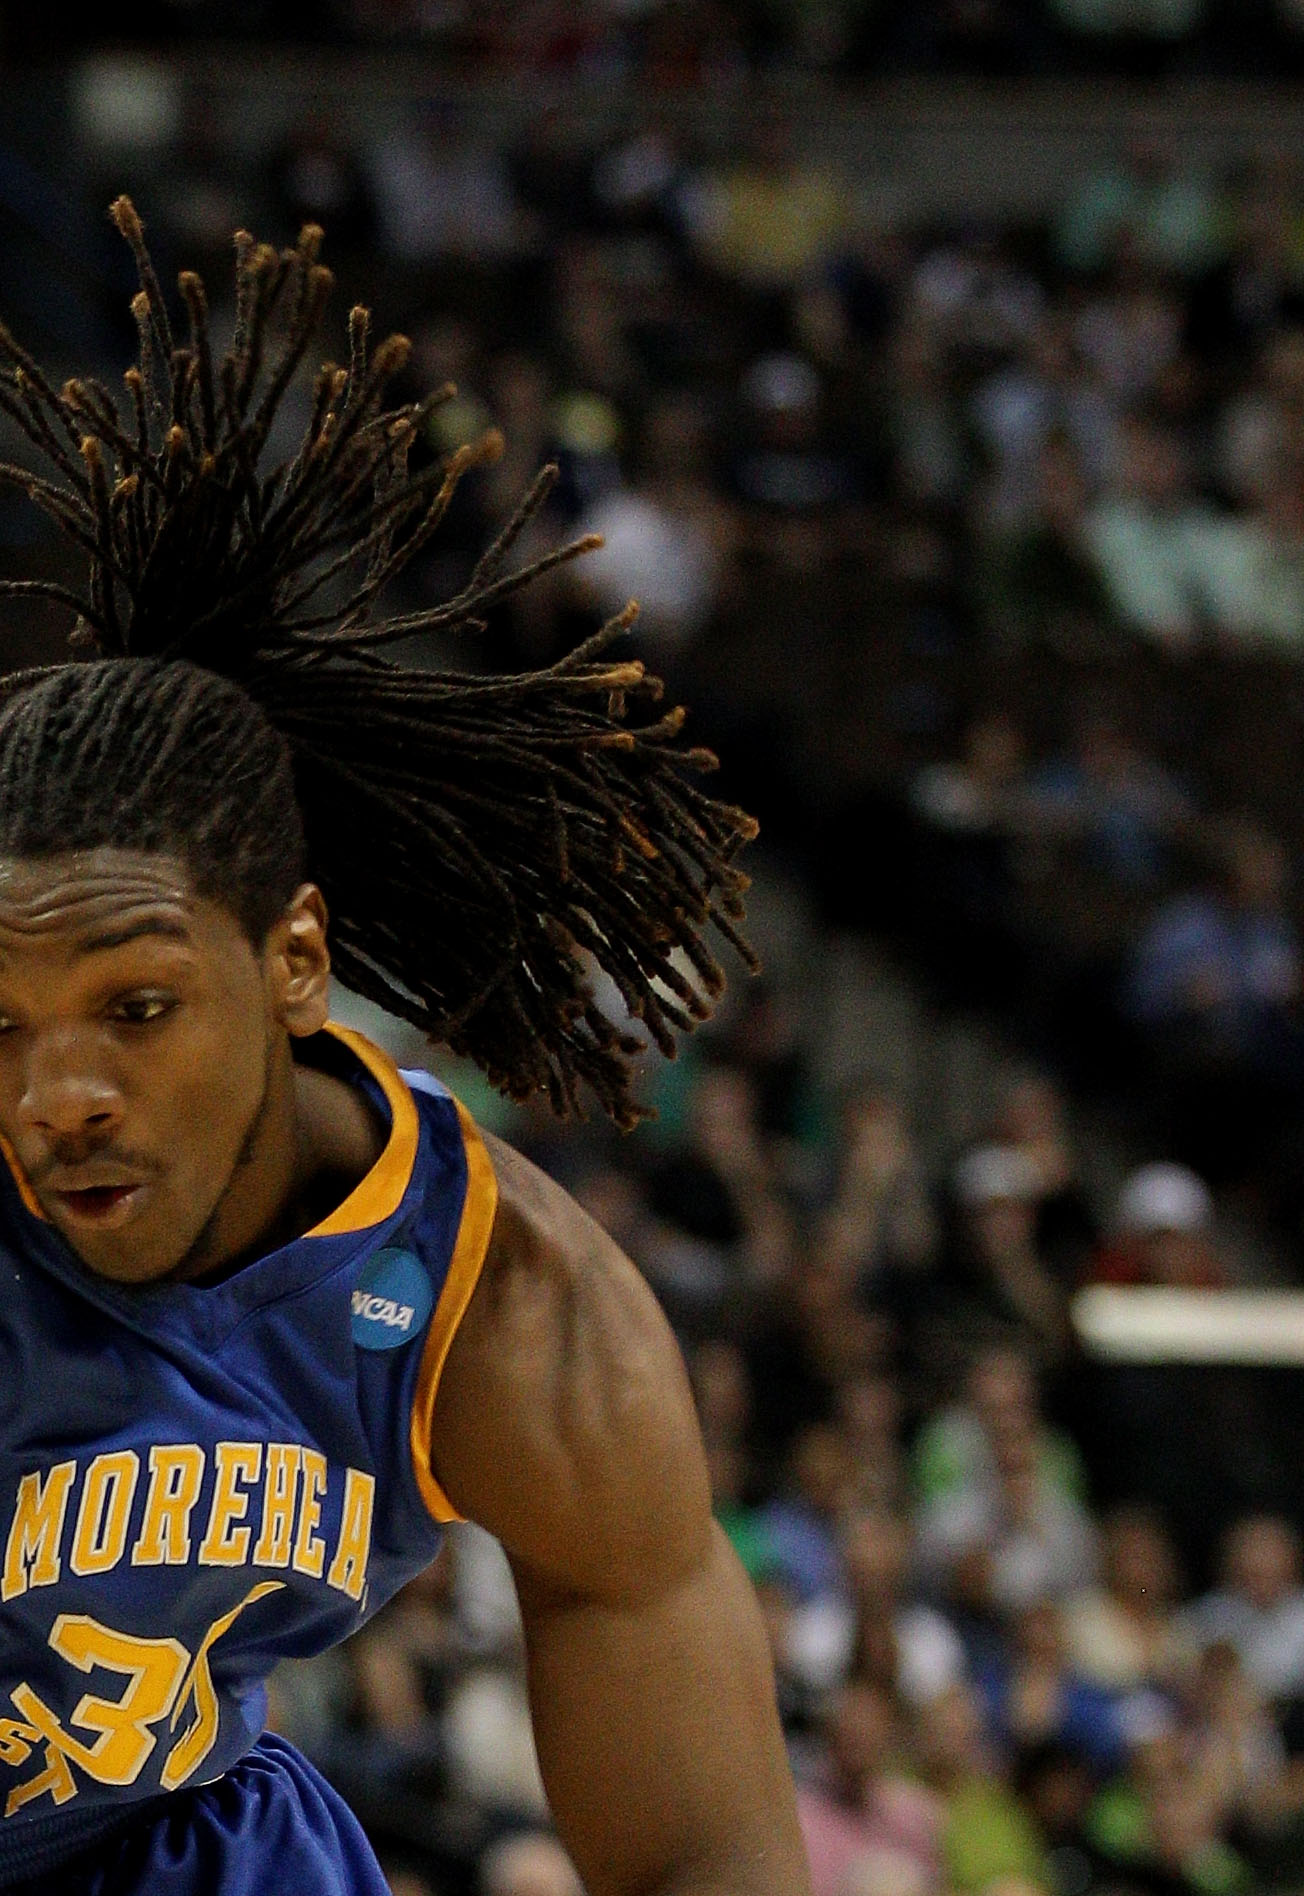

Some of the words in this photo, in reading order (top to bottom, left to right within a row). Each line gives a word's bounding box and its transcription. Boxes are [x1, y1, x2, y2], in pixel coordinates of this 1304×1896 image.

[351, 1290, 415, 1332] NCAA
[1, 1441, 377, 1612] MOREHEA
[9, 1580, 286, 1791] 3
